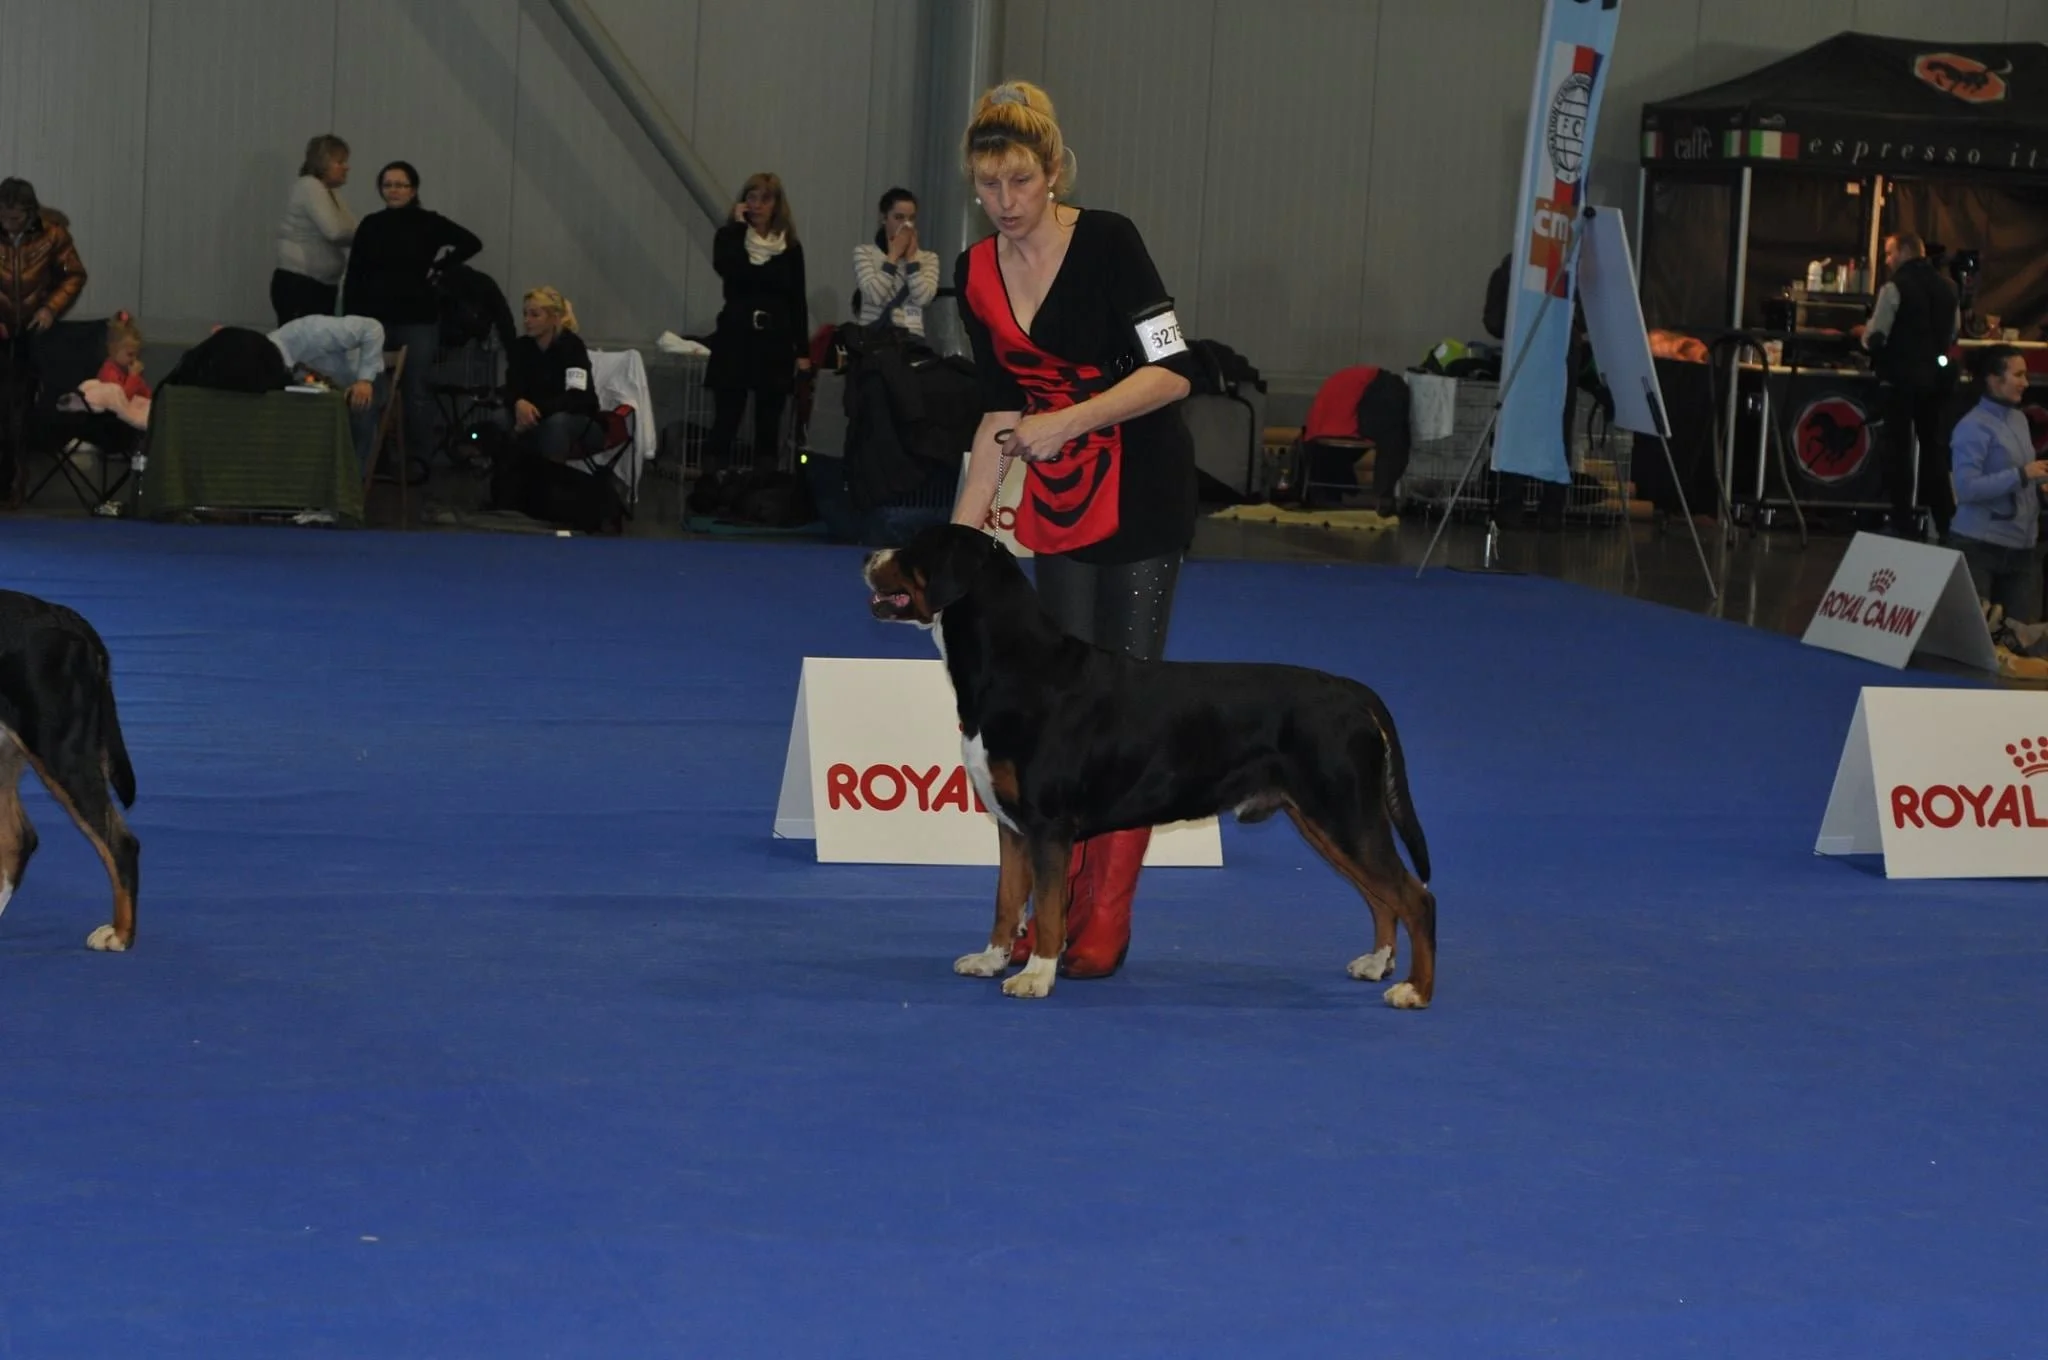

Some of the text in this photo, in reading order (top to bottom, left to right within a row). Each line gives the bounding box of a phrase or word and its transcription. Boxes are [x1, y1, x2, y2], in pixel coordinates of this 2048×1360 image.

[1809, 138, 2048, 168] espresso it
[1819, 590, 1921, 637] ROYAL CANIN
[1891, 784, 2048, 828] ROYAL
